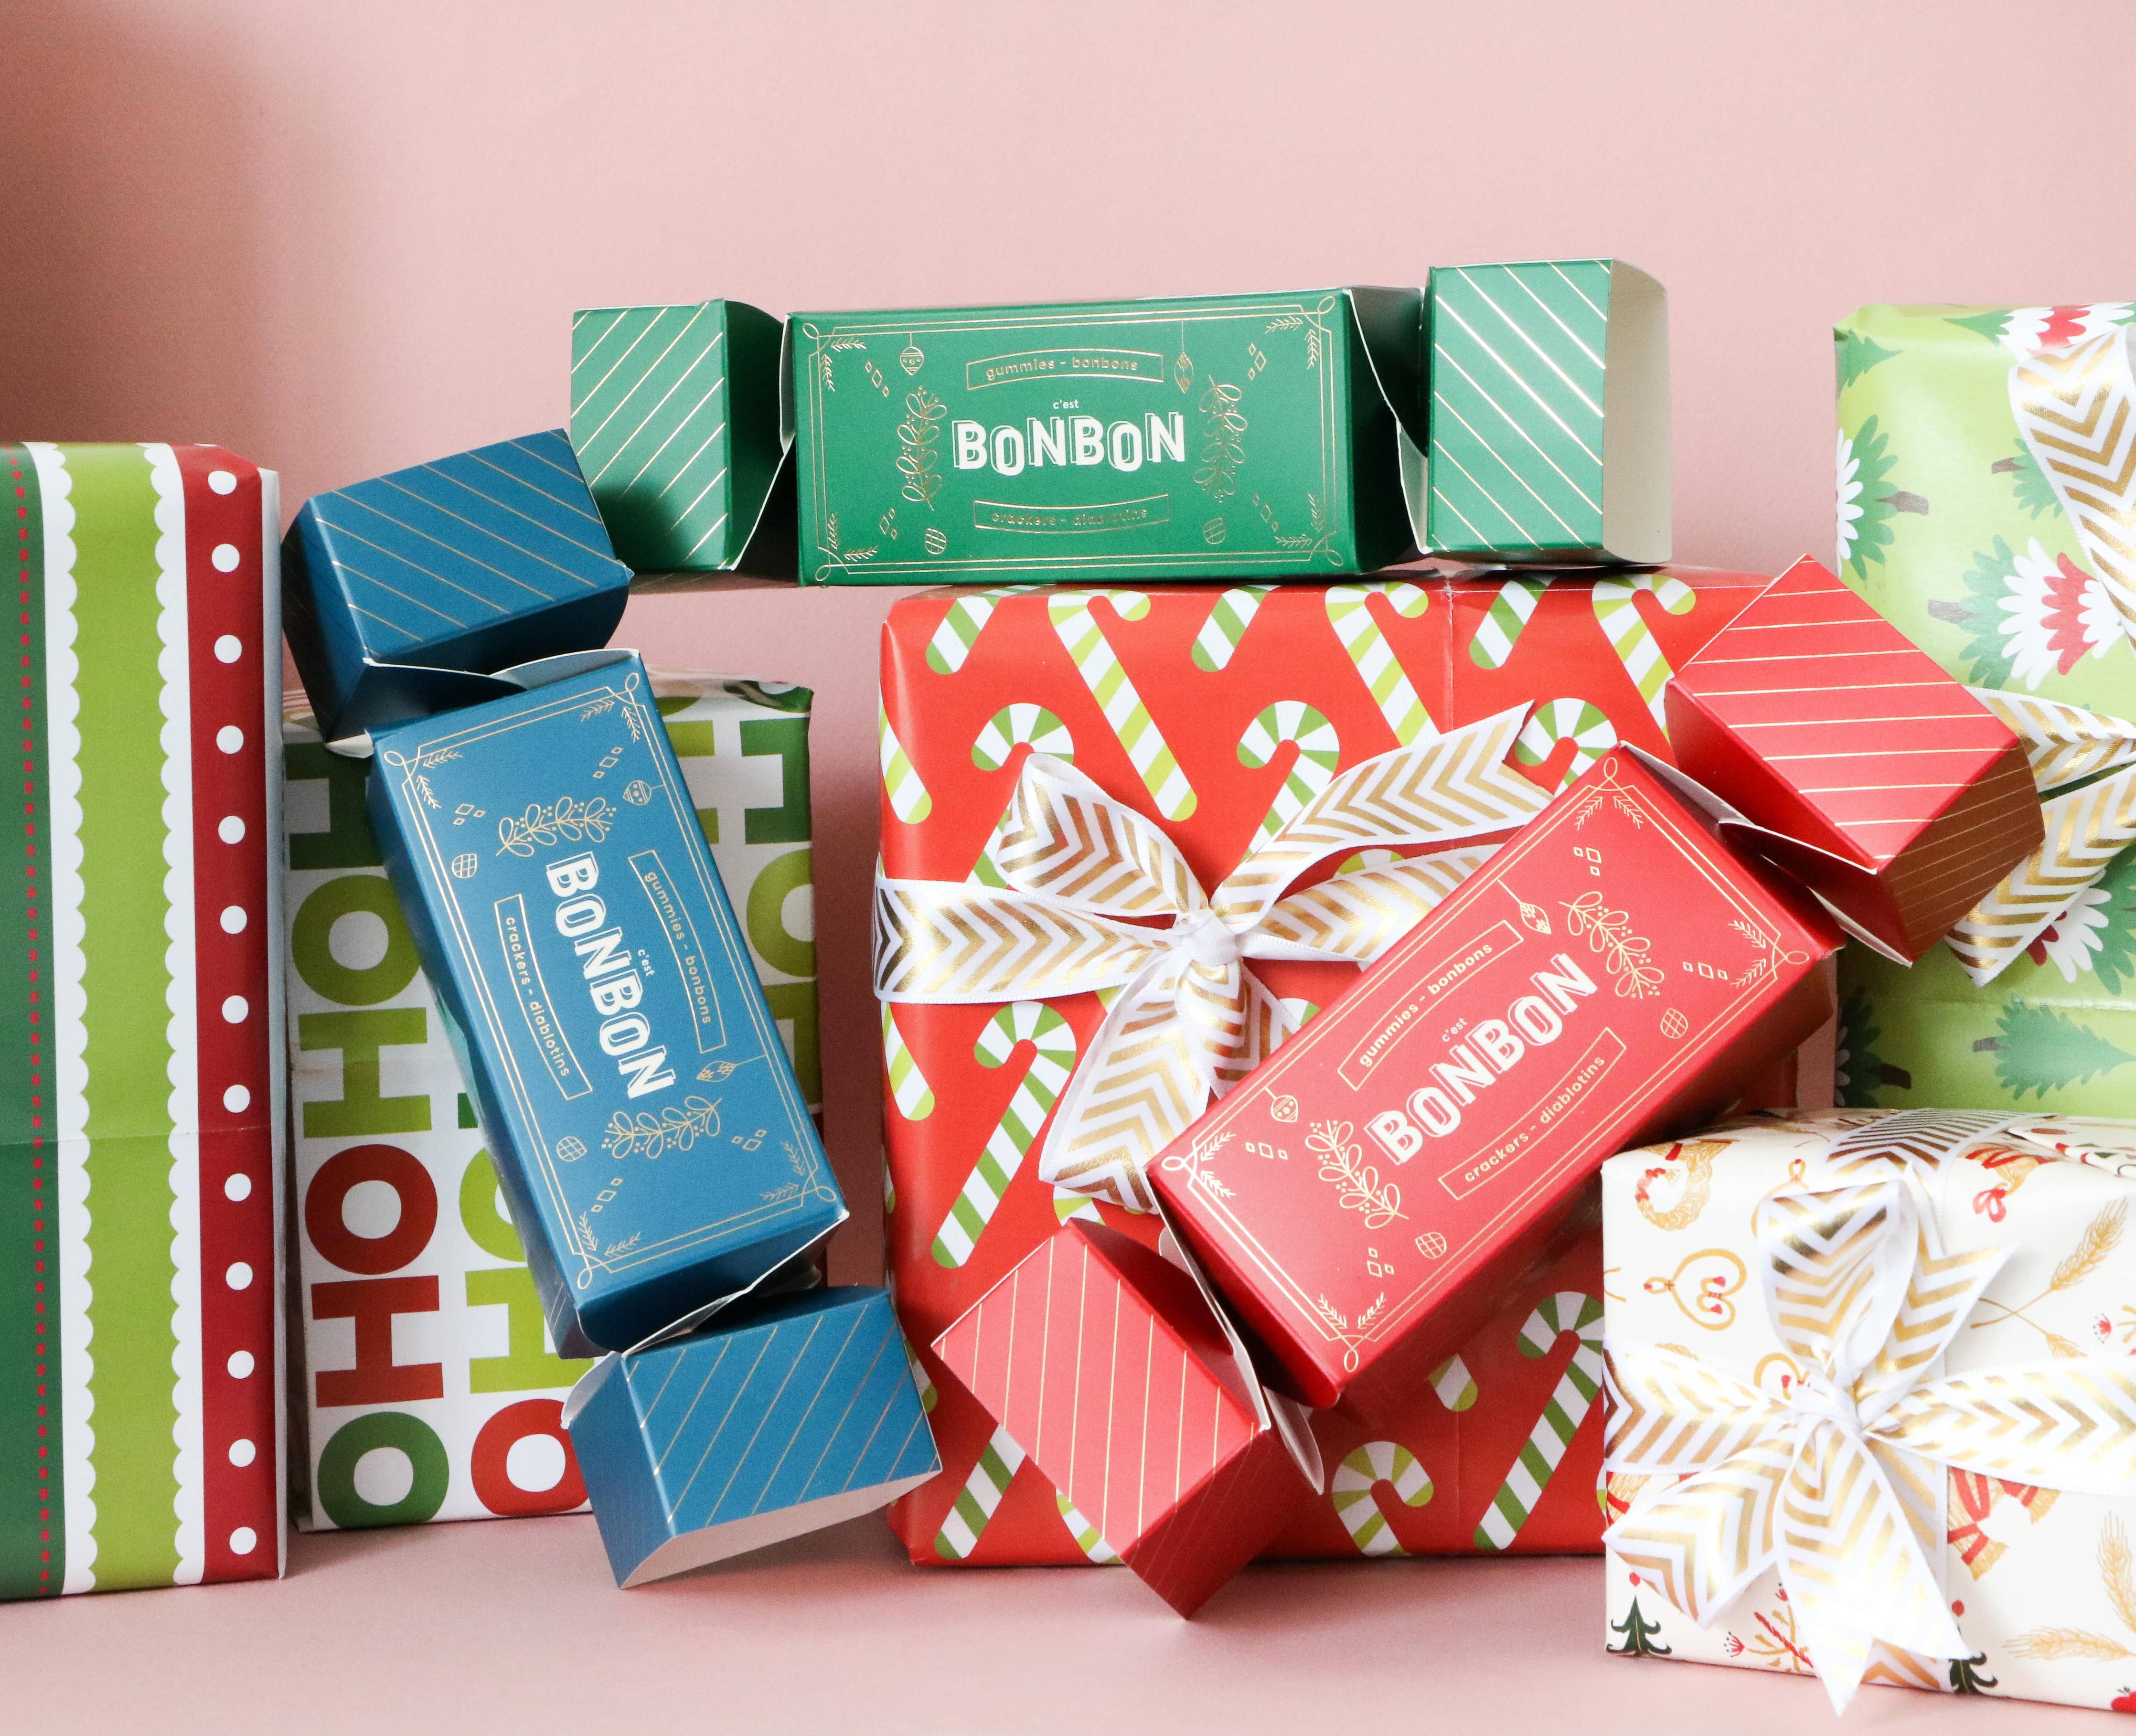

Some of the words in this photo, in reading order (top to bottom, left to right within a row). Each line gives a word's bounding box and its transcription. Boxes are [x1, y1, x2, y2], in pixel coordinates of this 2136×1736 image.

[986, 359, 1055, 381] gummies
[1072, 357, 1138, 371] bonbons
[1053, 399, 1079, 410] c'est
[952, 412, 1185, 476] BONBON
[992, 512, 1057, 526] crackers
[1073, 509, 1148, 526] diabtins
[546, 851, 676, 1099] BONBON
[638, 948, 655, 977] c'est
[644, 872, 685, 940] gummies
[685, 955, 711, 1024] bonbons
[505, 916, 531, 985] crackers
[529, 1001, 570, 1077] diablotins
[1359, 1003, 1419, 1068] gummies
[1427, 943, 1493, 995] bonbons
[1442, 1017, 1468, 1043] c'est
[1364, 953, 1598, 1166] BONBON
[1464, 1131, 1529, 1182] crackers
[1540, 1057, 1605, 1124] diablotins
